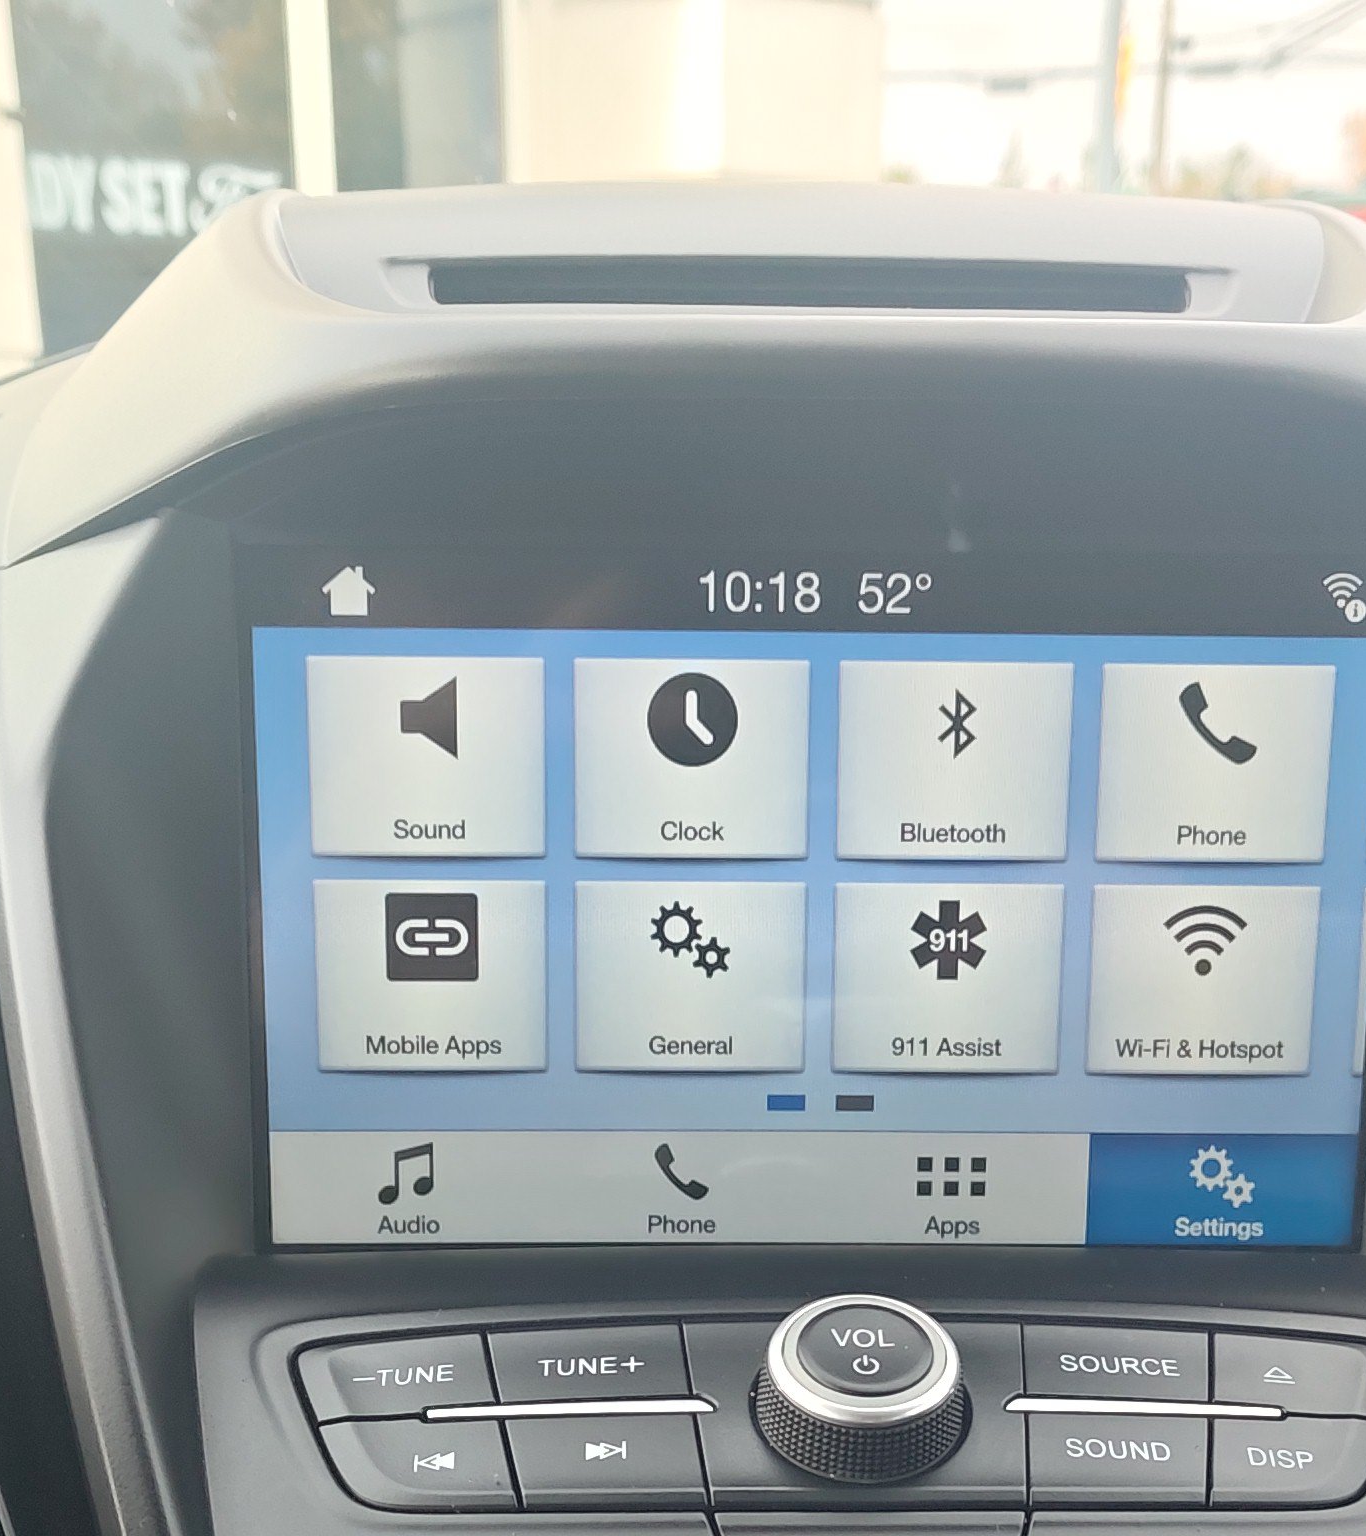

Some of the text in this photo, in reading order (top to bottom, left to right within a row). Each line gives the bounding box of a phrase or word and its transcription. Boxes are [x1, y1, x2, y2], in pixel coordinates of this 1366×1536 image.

[98, 156, 191, 237] SET
[698, 569, 934, 615] 10:18 52°
[392, 818, 467, 841] Sound
[659, 819, 726, 842] Clock
[899, 822, 1006, 844] Bluetooth
[1176, 824, 1248, 846] Phone
[928, 928, 970, 954] 911
[365, 1035, 502, 1060] Mobile Apps
[647, 1034, 734, 1056] General
[891, 1036, 1003, 1058] 911 Assist
[1115, 1038, 1284, 1063] Wi-Fi & Hotspot
[377, 1214, 441, 1235] Audio
[647, 1214, 717, 1234] Phone
[924, 1215, 981, 1240] Apps
[1174, 1216, 1265, 1241] Settings
[829, 1327, 896, 1349] VOL
[1058, 1353, 1182, 1378] SOURCE
[1065, 1437, 1172, 1463] SOUND
[1246, 1446, 1314, 1471] DISP
